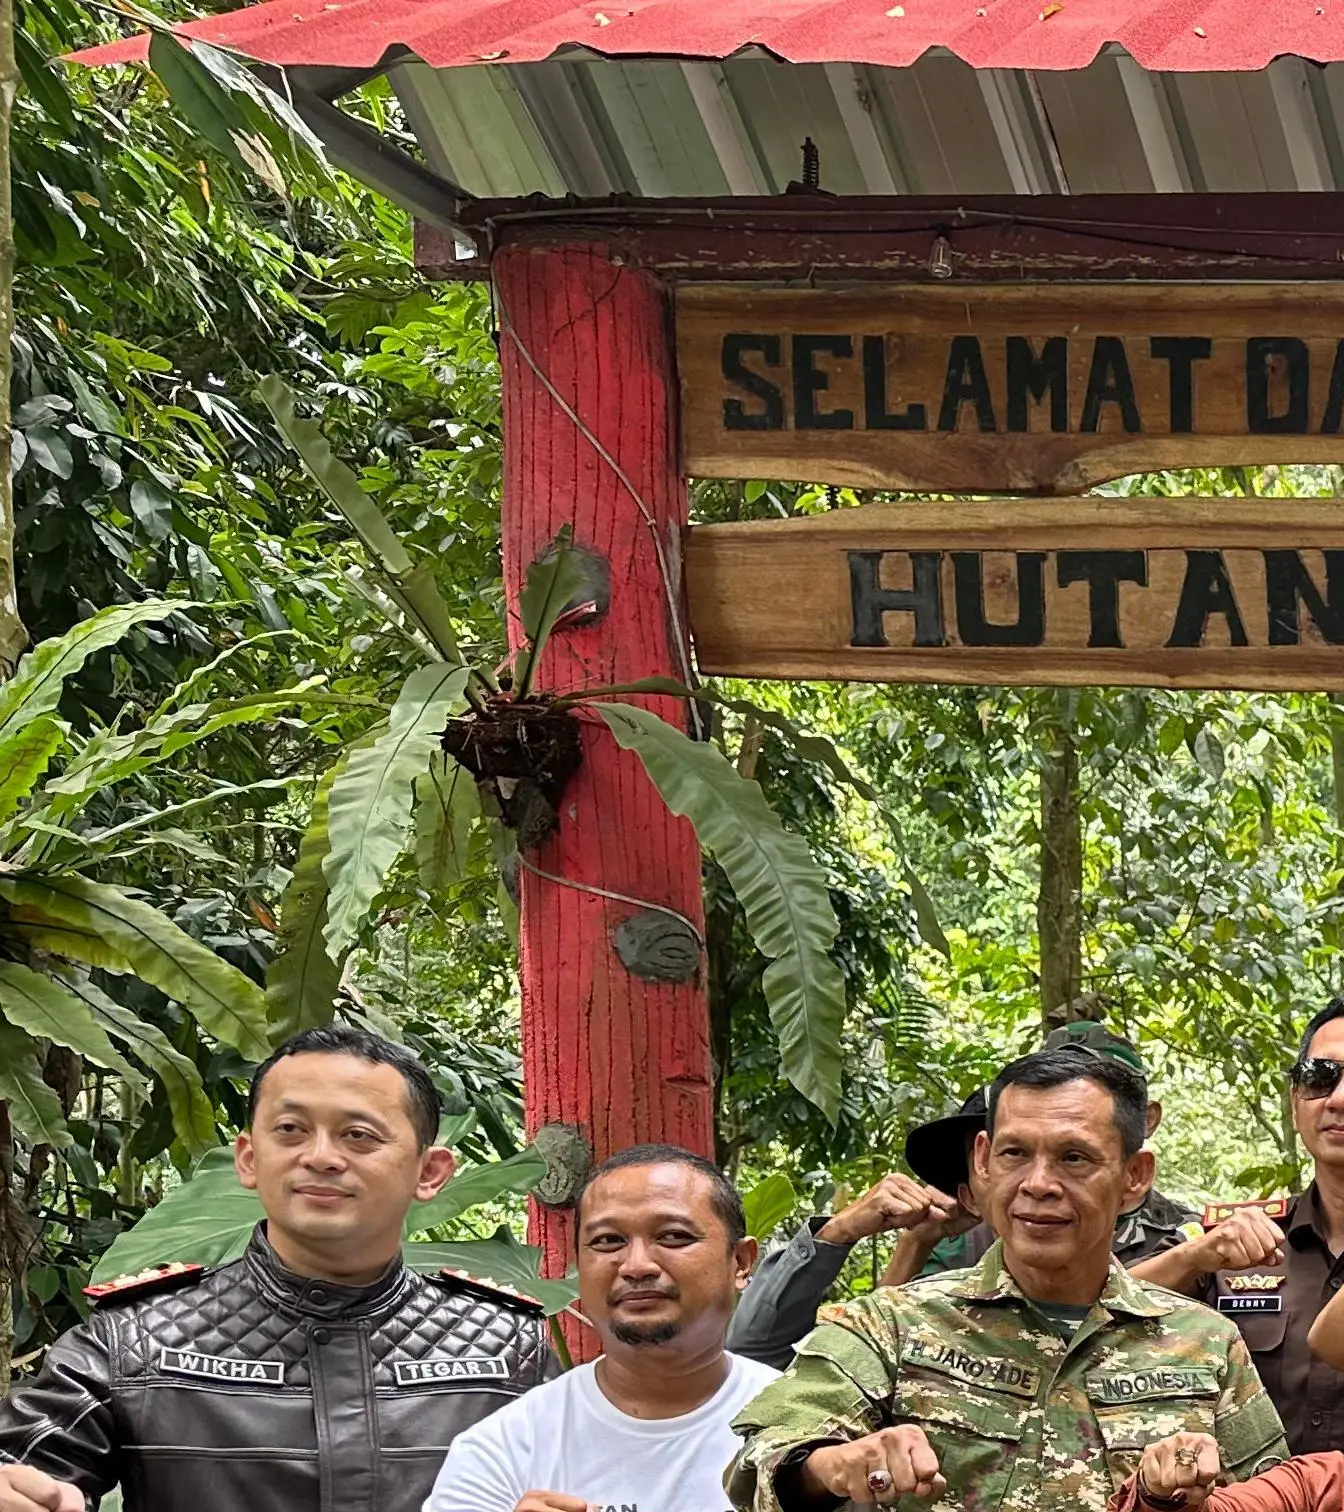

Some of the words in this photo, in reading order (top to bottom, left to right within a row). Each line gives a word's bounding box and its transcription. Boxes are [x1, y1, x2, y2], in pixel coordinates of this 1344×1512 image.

[720, 332, 1213, 433] SELAMAT
[177, 1353, 267, 1379] WIKHA
[406, 1361, 481, 1380] TEGAR
[487, 1358, 498, 1375] 1
[930, 1345, 984, 1378] JARO
[1103, 1371, 1204, 1398] INDONESIA
